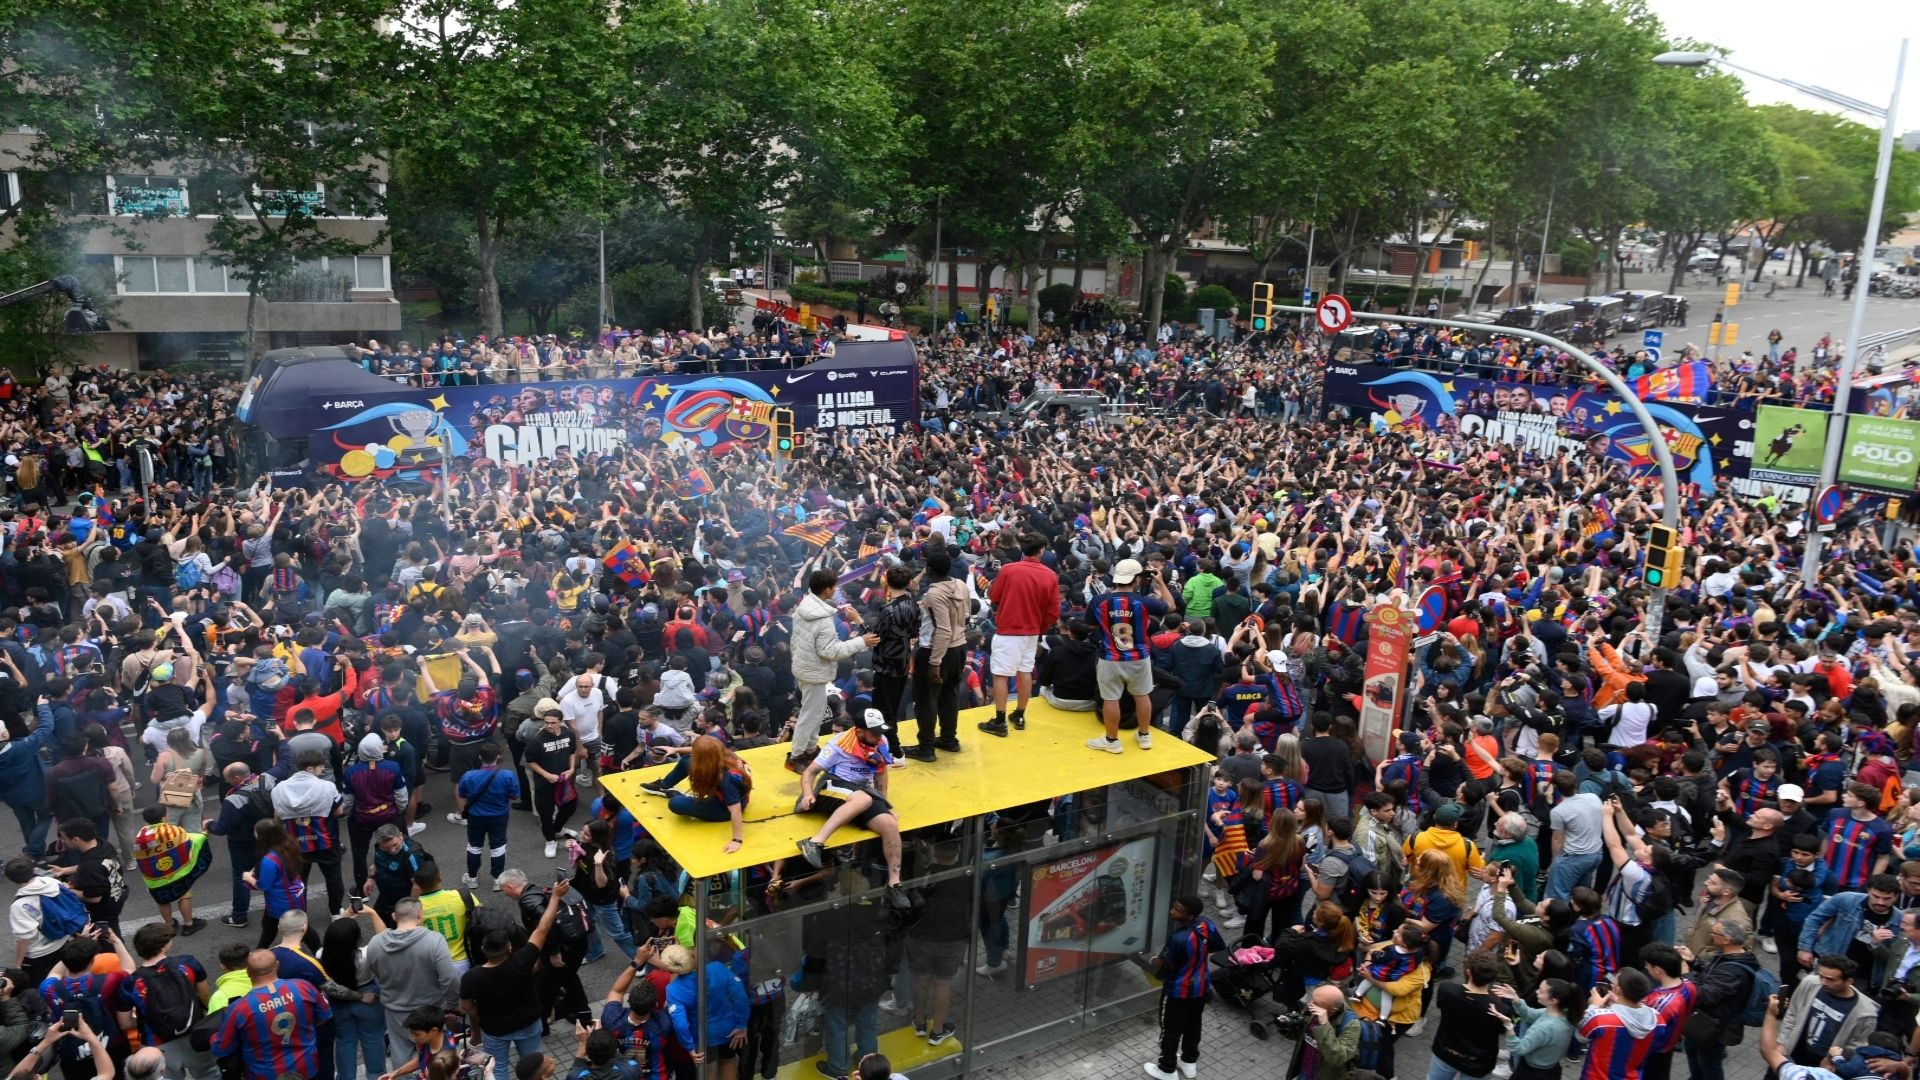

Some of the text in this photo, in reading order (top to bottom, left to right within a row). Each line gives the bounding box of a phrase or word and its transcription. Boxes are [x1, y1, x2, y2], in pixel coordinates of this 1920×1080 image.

[334, 400, 364, 409] BARÇA
[817, 390, 874, 409] LA LLIGA
[818, 408, 835, 428] ÉS
[1852, 444, 1914, 464] POLO
[1109, 609, 1134, 618] PEDRI
[1111, 622, 1134, 651] 8
[258, 991, 295, 1013] GARLY
[271, 1011, 297, 1045] 9
